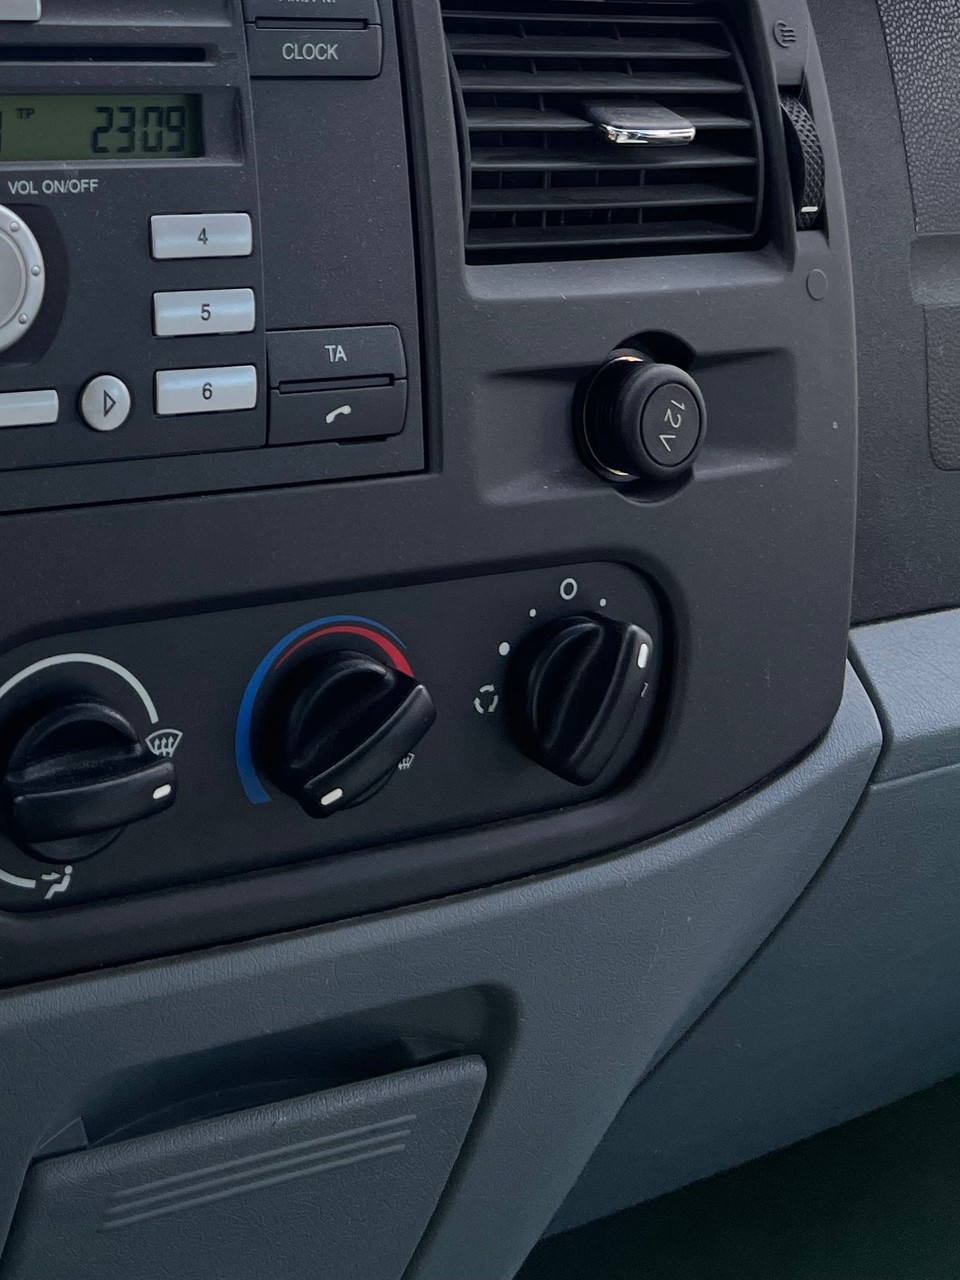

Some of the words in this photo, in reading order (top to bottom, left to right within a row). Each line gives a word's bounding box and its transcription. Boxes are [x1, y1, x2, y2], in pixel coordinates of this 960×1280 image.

[282, 42, 338, 61] CLOCK
[92, 106, 186, 154] 2309
[8, 180, 38, 195] VOL
[42, 178, 99, 194] ON/OFF
[197, 228, 208, 245] 4
[200, 304, 211, 321] 5
[325, 345, 347, 362] TA
[202, 383, 213, 400] 6
